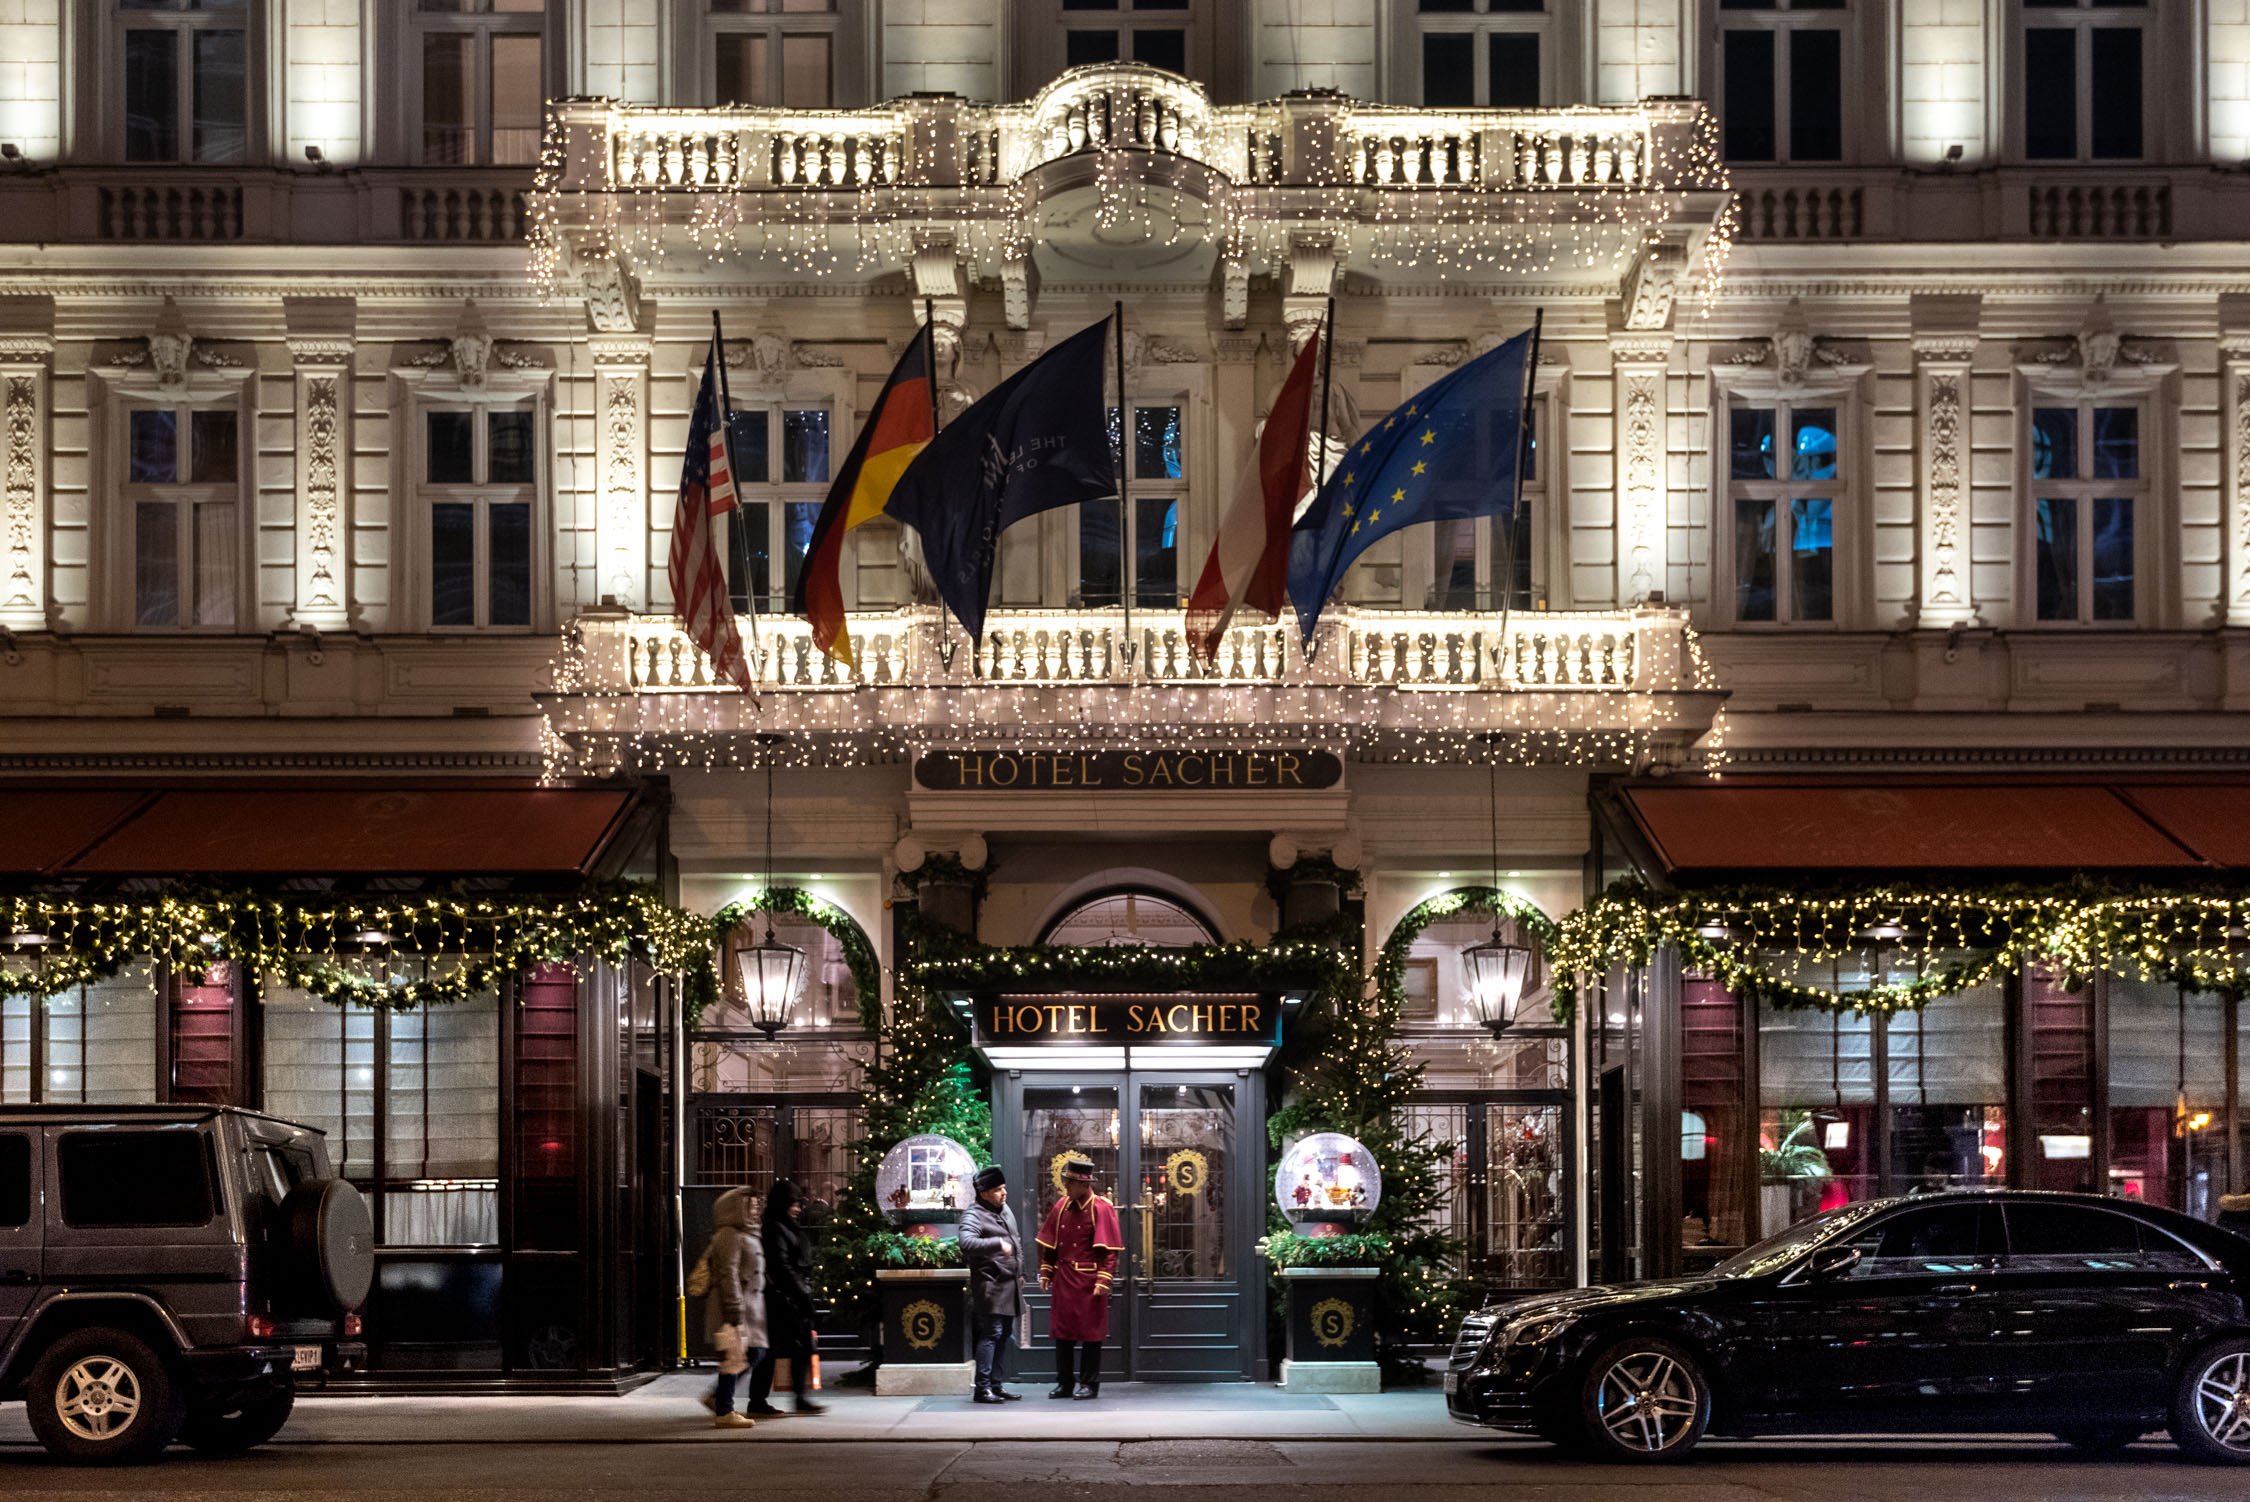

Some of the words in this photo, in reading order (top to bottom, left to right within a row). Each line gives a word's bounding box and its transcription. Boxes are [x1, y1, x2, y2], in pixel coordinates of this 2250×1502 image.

[959, 756, 1101, 785] HOTEL
[1123, 755, 1303, 785] SACHER
[993, 1005, 1107, 1033] HOTEL
[1127, 1004, 1261, 1033] SACHER
[1181, 1166, 1193, 1184] S
[918, 1317, 930, 1336] S
[1327, 1315, 1339, 1334] S
